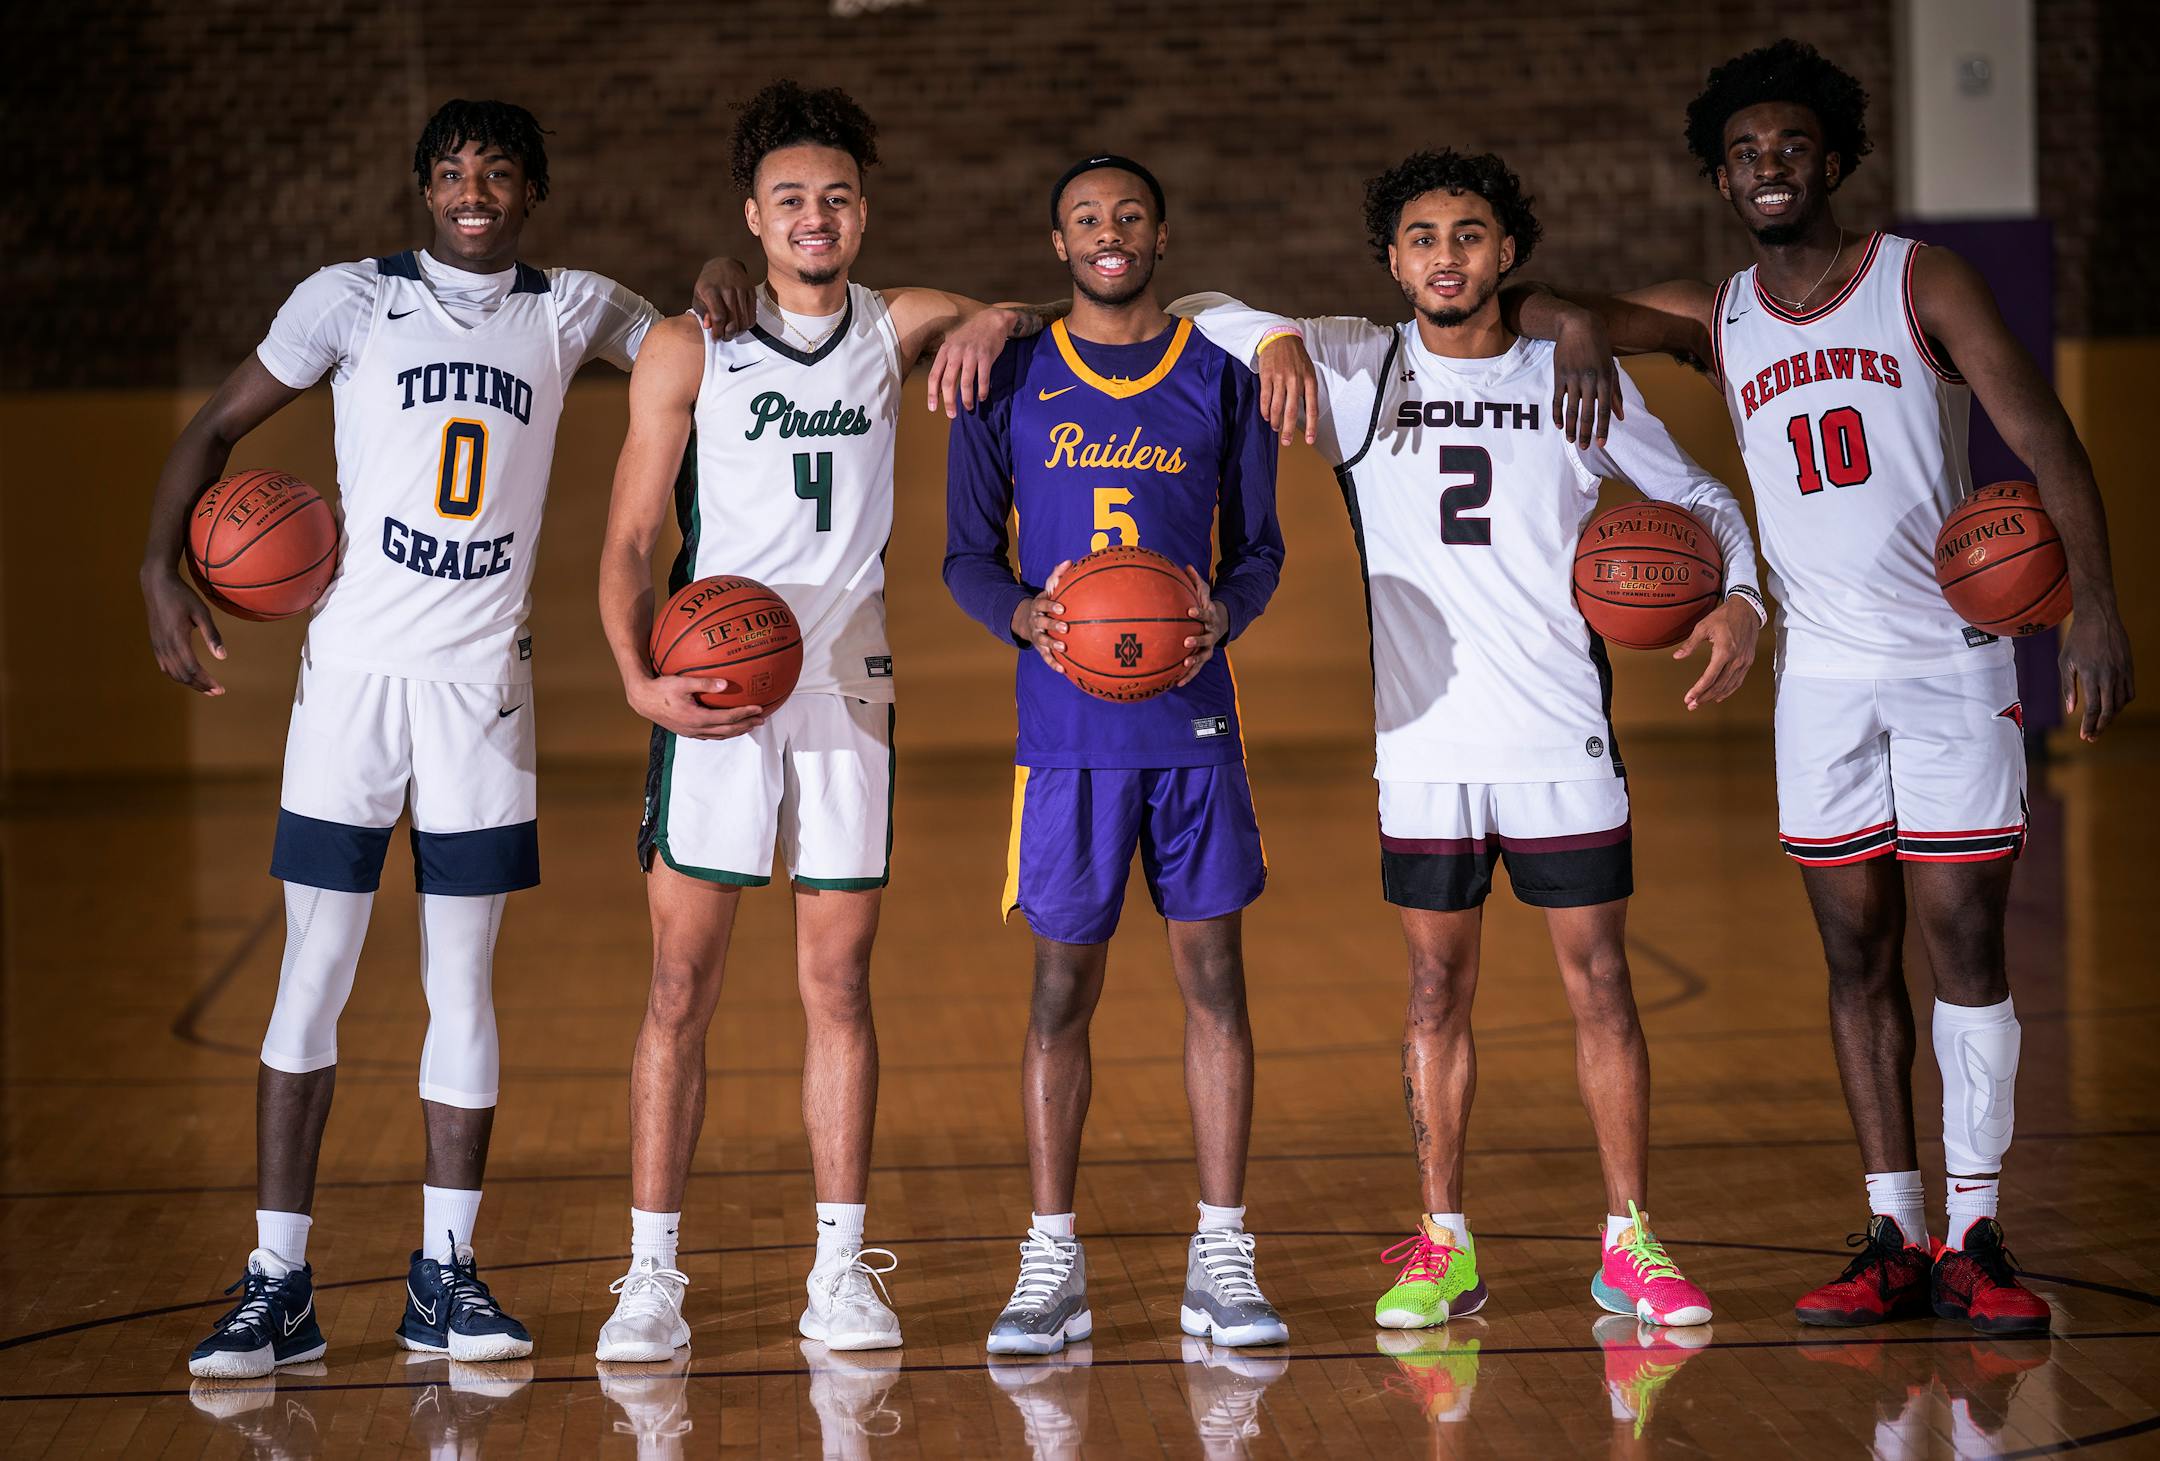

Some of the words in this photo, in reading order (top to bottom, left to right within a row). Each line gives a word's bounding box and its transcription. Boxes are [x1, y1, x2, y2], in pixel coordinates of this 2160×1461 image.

[397, 362, 533, 425] TOTINO
[1741, 348, 1902, 420] REDHAWKS
[745, 391, 872, 441] Pirates
[1397, 400, 1539, 430] SOUTH
[434, 417, 489, 521] 0
[1045, 422, 1187, 474] Raiders
[1787, 406, 1872, 496] 10
[792, 452, 832, 532] 4
[1091, 487, 1140, 552] 5
[1440, 445, 1492, 546] 2
[383, 516, 514, 580] GRACE
[1596, 518, 1698, 552] SPALDING
[1938, 513, 2027, 569] SPALDING
[1594, 562, 1690, 583] TF-1000
[1620, 581, 1660, 590] LEGACY
[702, 609, 790, 646] TF-1000
[739, 627, 774, 644] LEGACY
